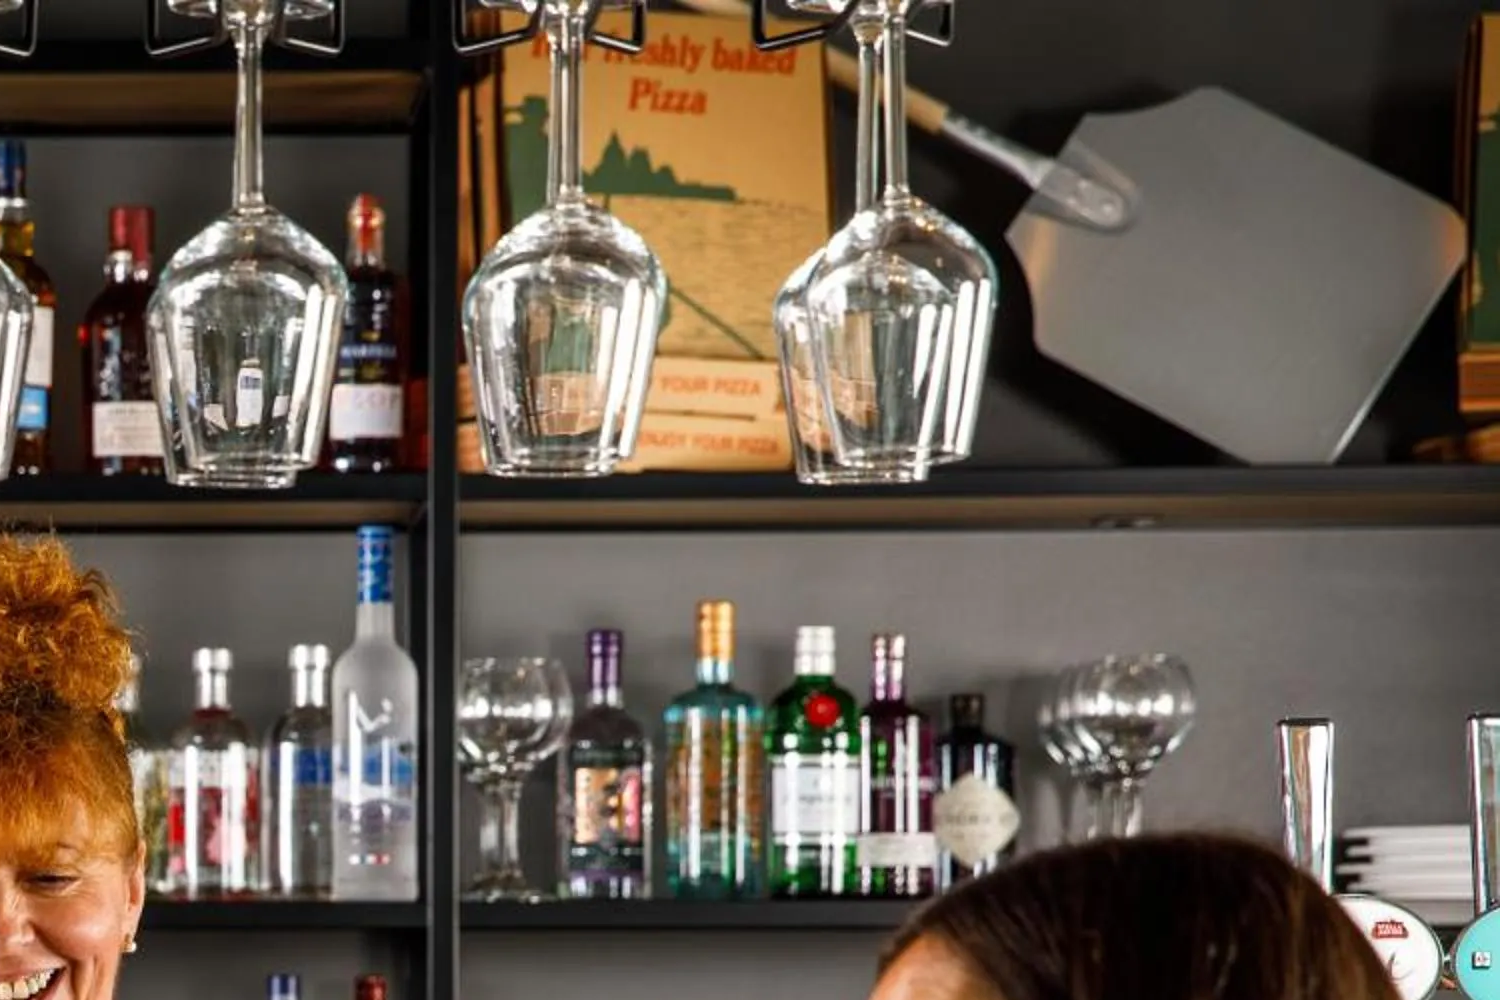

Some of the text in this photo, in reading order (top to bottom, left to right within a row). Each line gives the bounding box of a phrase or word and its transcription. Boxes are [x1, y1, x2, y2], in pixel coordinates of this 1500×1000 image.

[628, 76, 707, 115] Pizza
[661, 375, 761, 395] YOUR PIZZA
